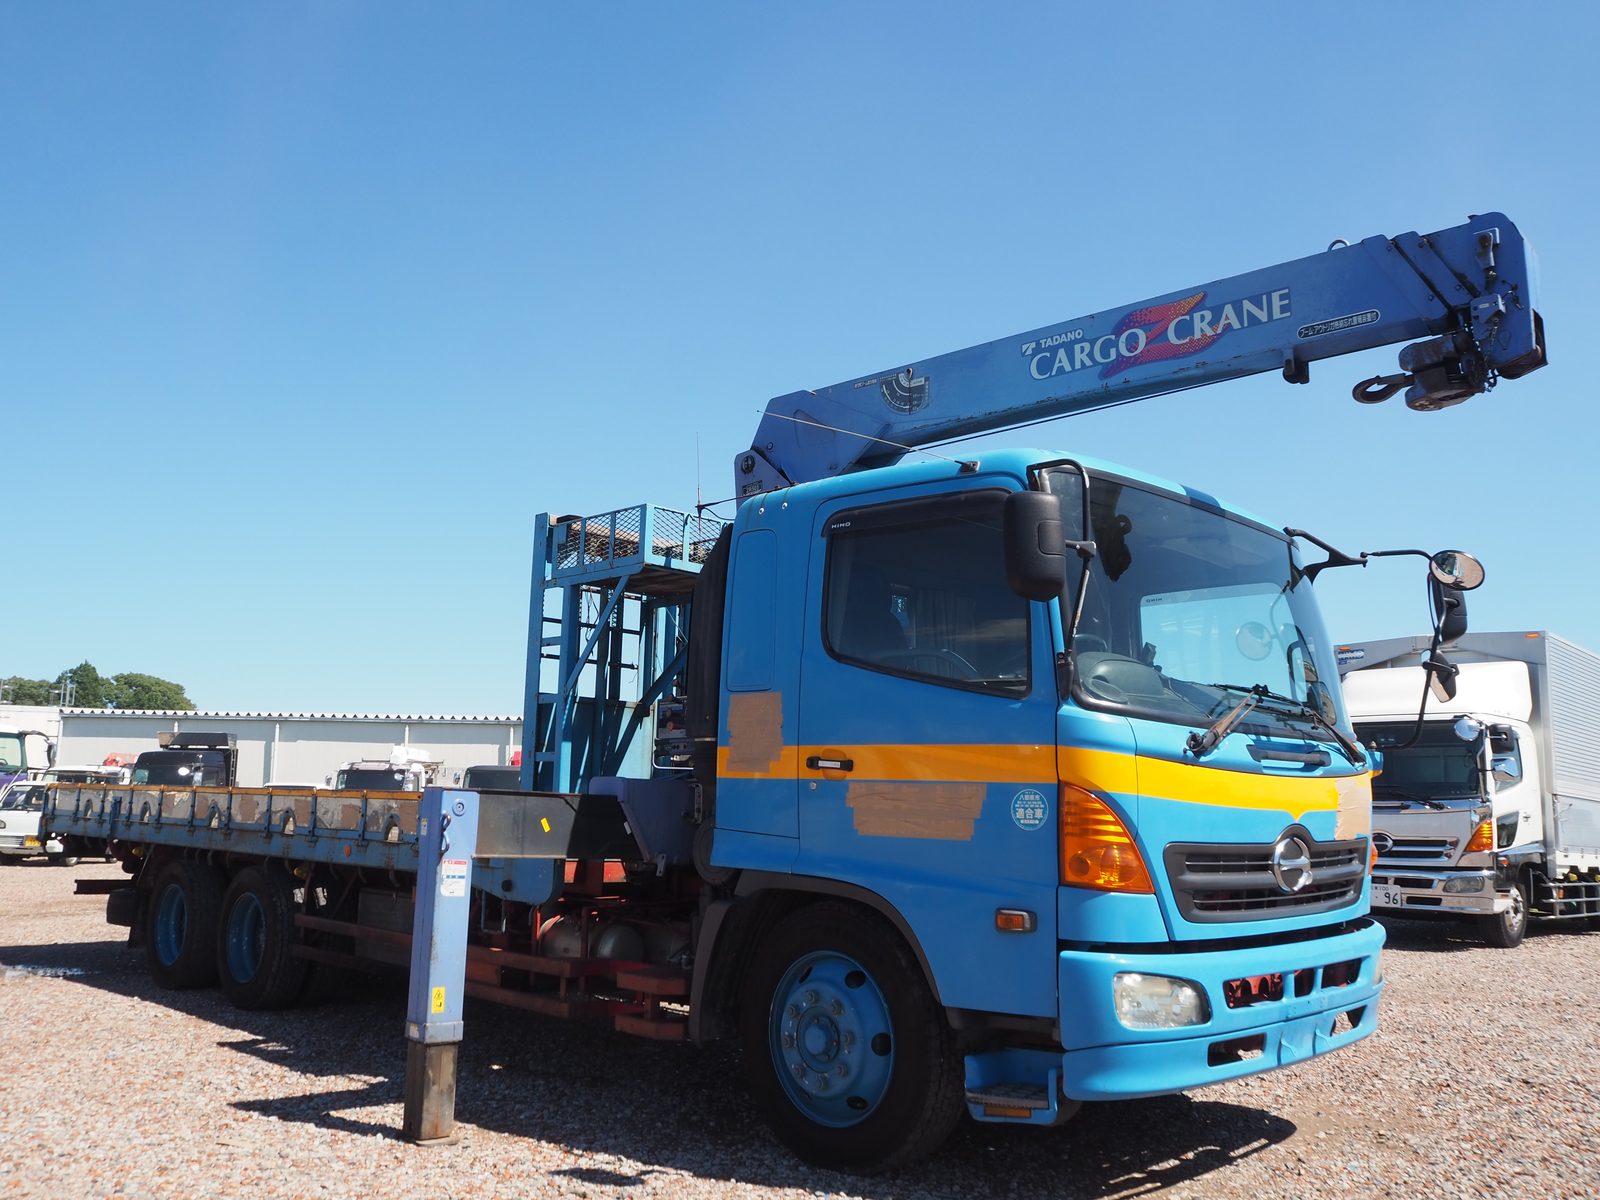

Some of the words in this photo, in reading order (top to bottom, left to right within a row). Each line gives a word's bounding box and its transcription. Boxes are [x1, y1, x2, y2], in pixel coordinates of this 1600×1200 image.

[1029, 328, 1147, 380] CARGO
[1166, 288, 1292, 345] CRANE
[1039, 328, 1084, 348] TADANO
[831, 521, 851, 529] HINO
[1016, 808, 1044, 819] 適合車
[1384, 892, 1398, 905] 96
